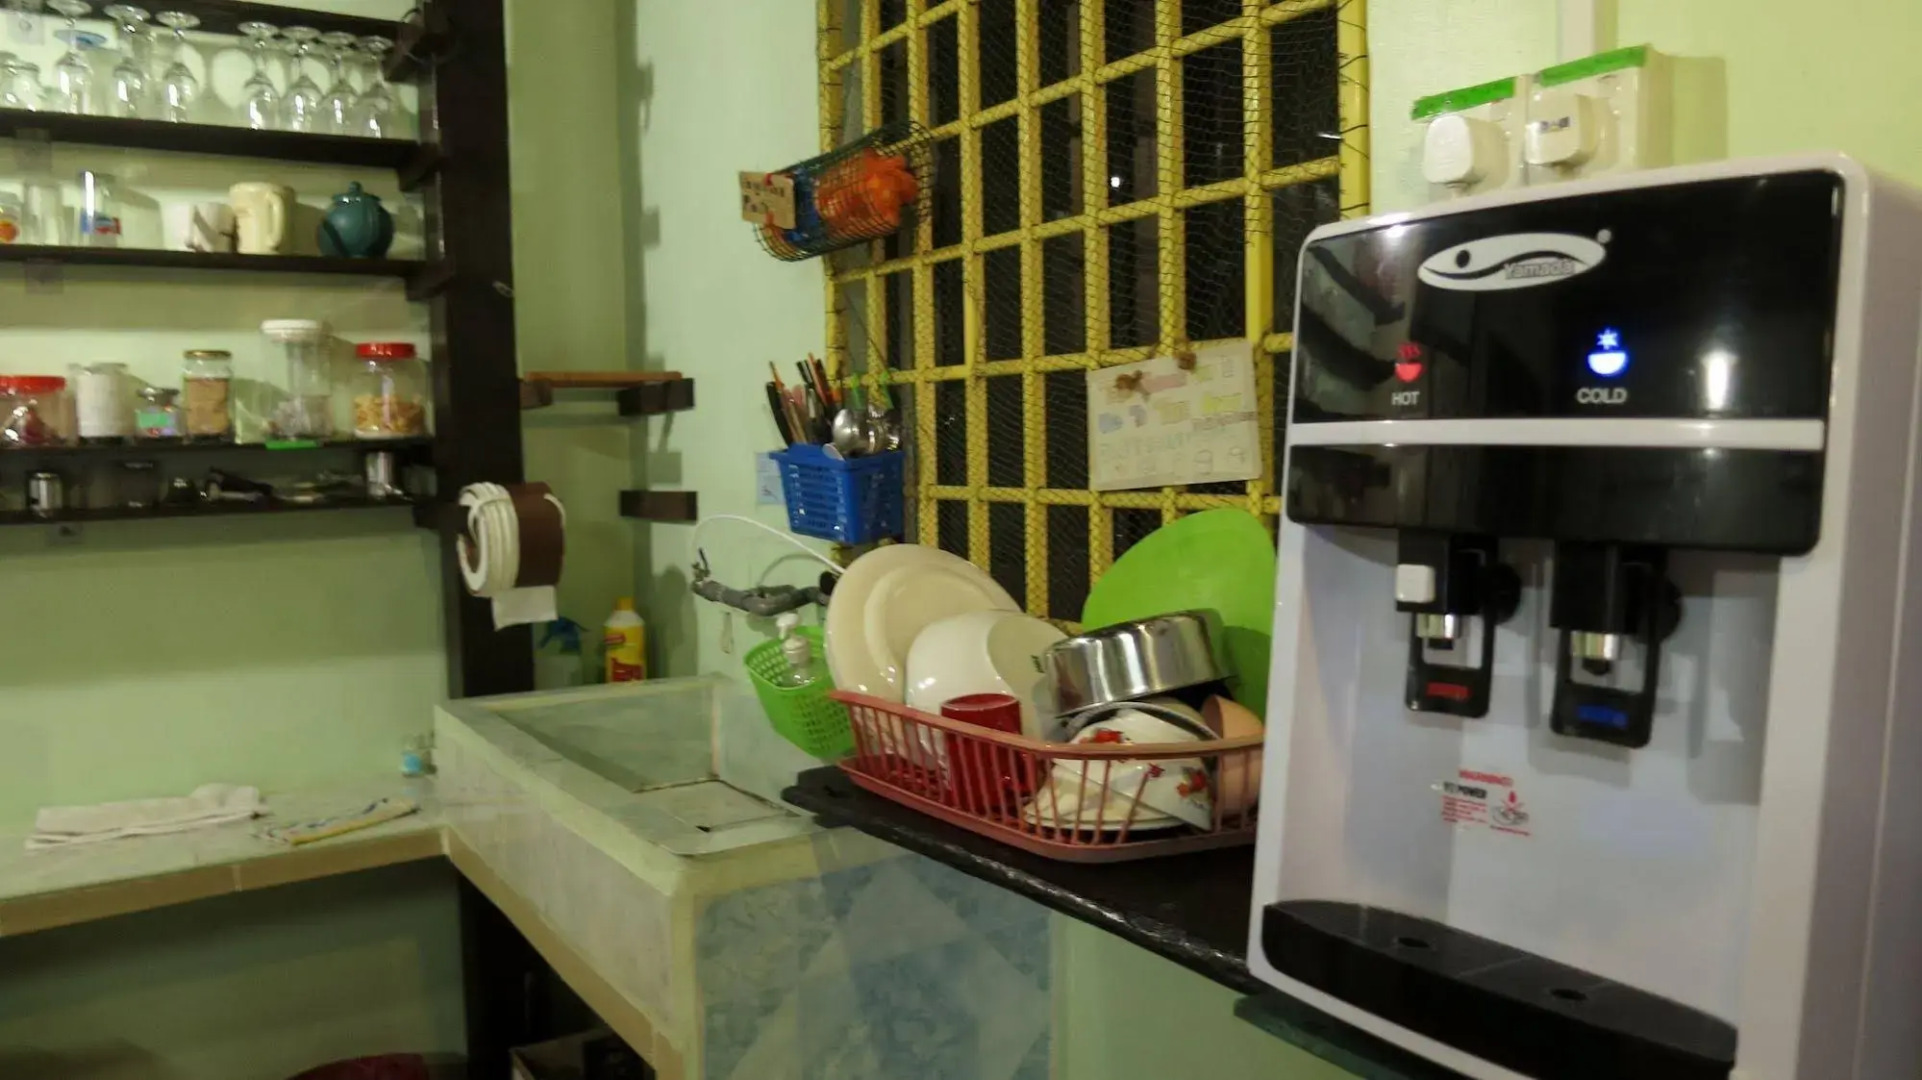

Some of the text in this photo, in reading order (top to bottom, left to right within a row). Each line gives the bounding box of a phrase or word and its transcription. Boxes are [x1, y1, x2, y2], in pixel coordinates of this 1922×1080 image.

[1504, 258, 1575, 279] Yamada
[1392, 391, 1420, 405] HOT
[1576, 387, 1628, 404] COLD
